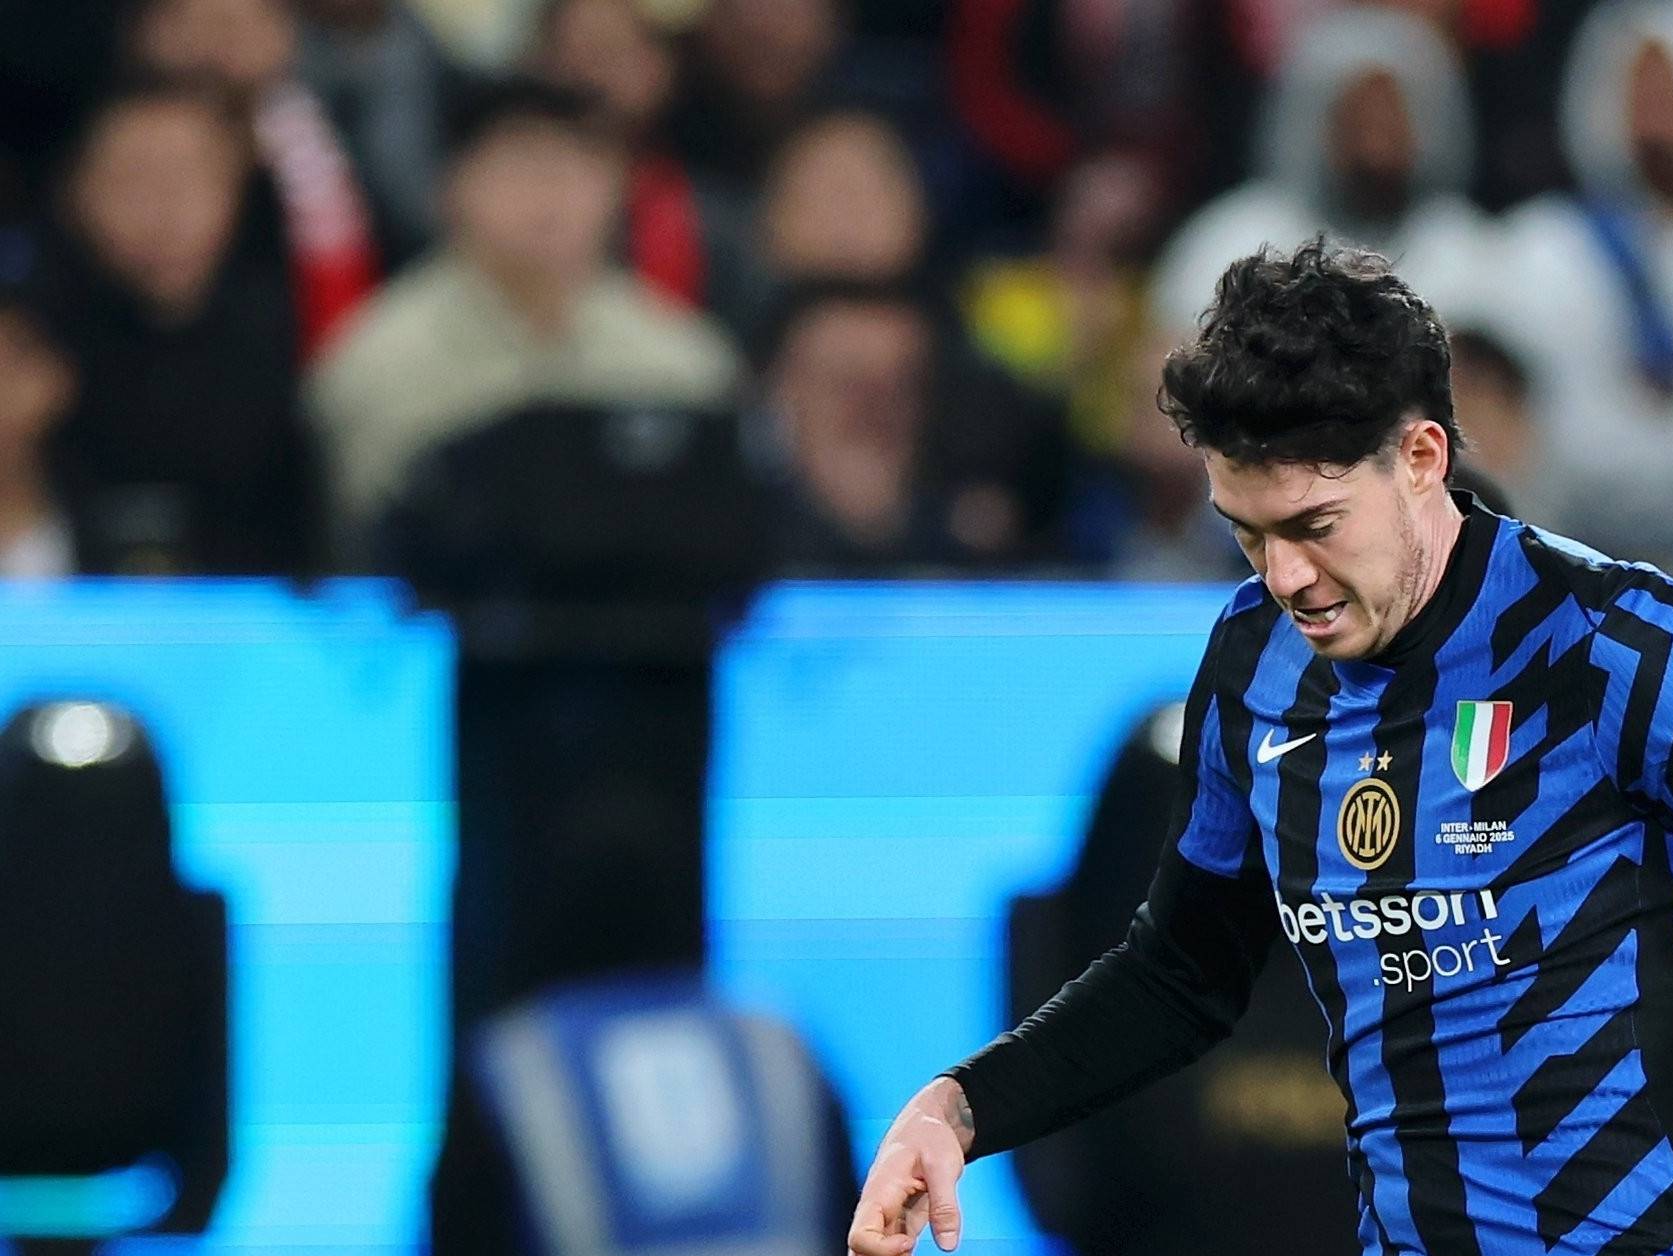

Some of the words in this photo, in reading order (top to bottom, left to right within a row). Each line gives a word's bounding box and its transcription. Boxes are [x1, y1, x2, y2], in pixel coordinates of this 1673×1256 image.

[1435, 833, 1442, 844] 6
[1443, 832, 1487, 844] GENNAIO
[1489, 830, 1515, 843] 2025
[1455, 843, 1493, 855] RIYADH
[1276, 890, 1498, 944] betsson
